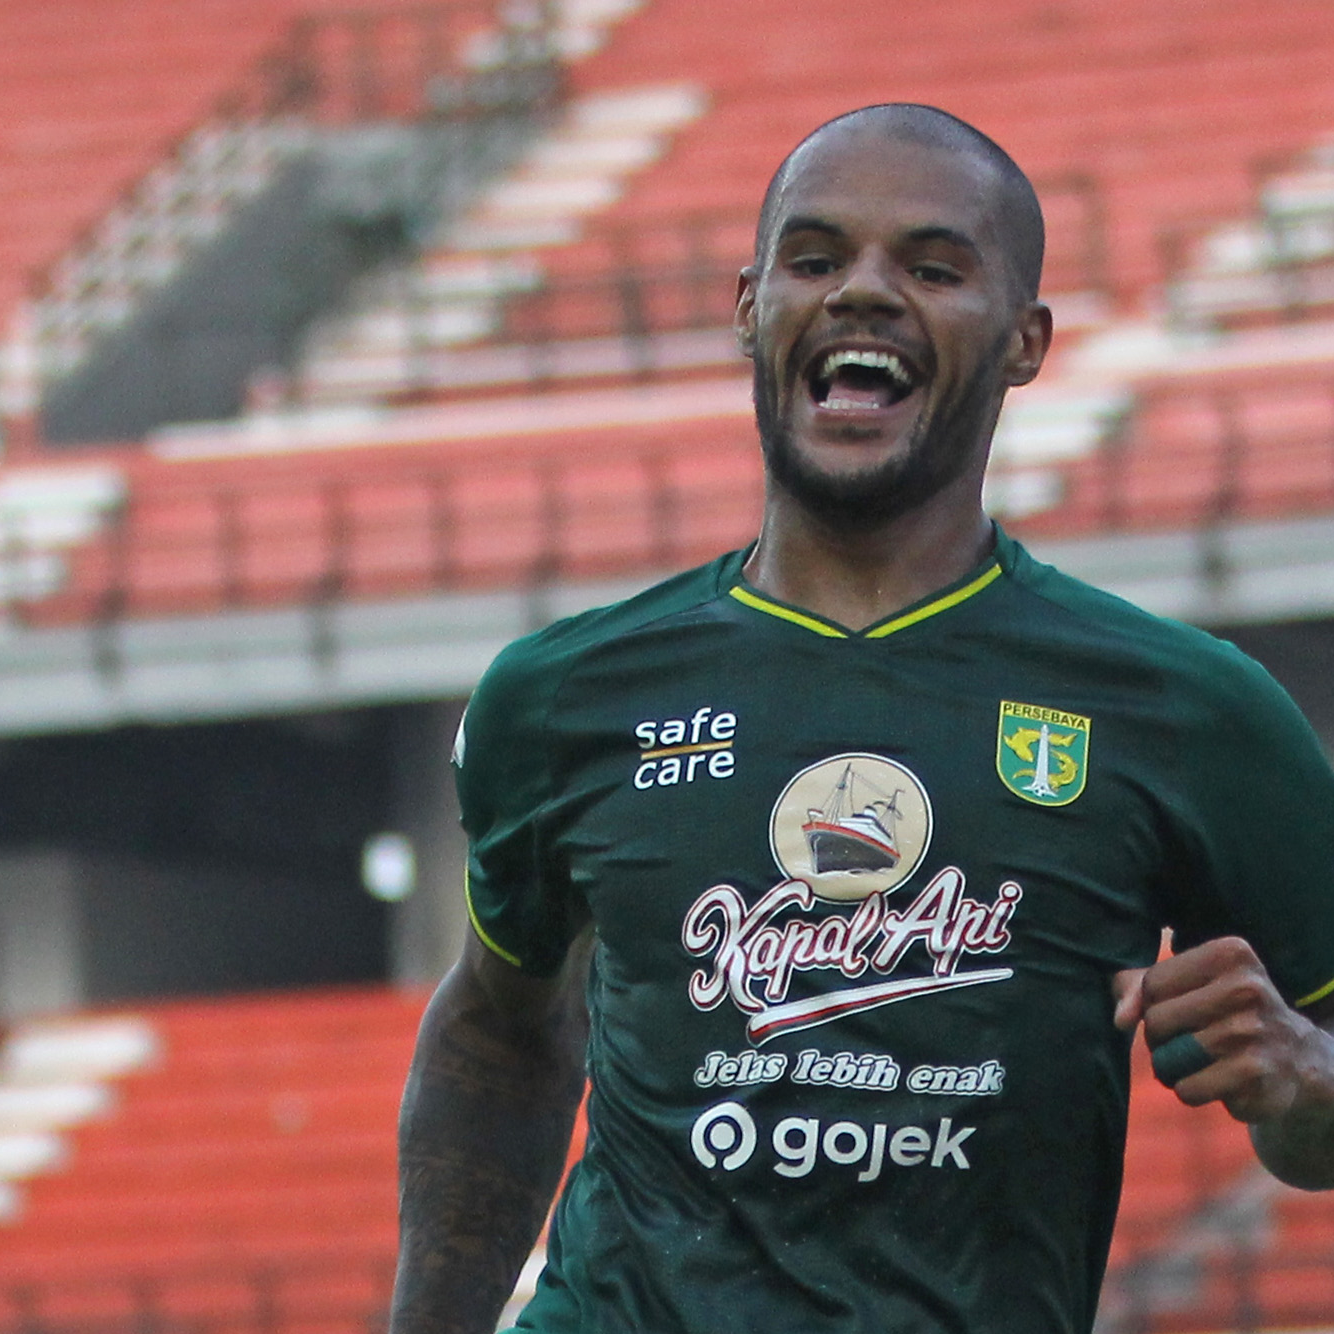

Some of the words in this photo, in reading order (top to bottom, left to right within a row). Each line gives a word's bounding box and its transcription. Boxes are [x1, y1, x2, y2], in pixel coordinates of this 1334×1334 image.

[634, 707, 738, 749] safe
[1003, 702, 1087, 729] PERSEBAYA
[633, 750, 736, 790] care
[682, 879, 886, 1013] Kapal
[871, 866, 1023, 979] Api
[695, 1049, 788, 1089] Jelas
[790, 1049, 902, 1093] lebih
[907, 1060, 1006, 1096] enak
[772, 1117, 977, 1183] gojek
